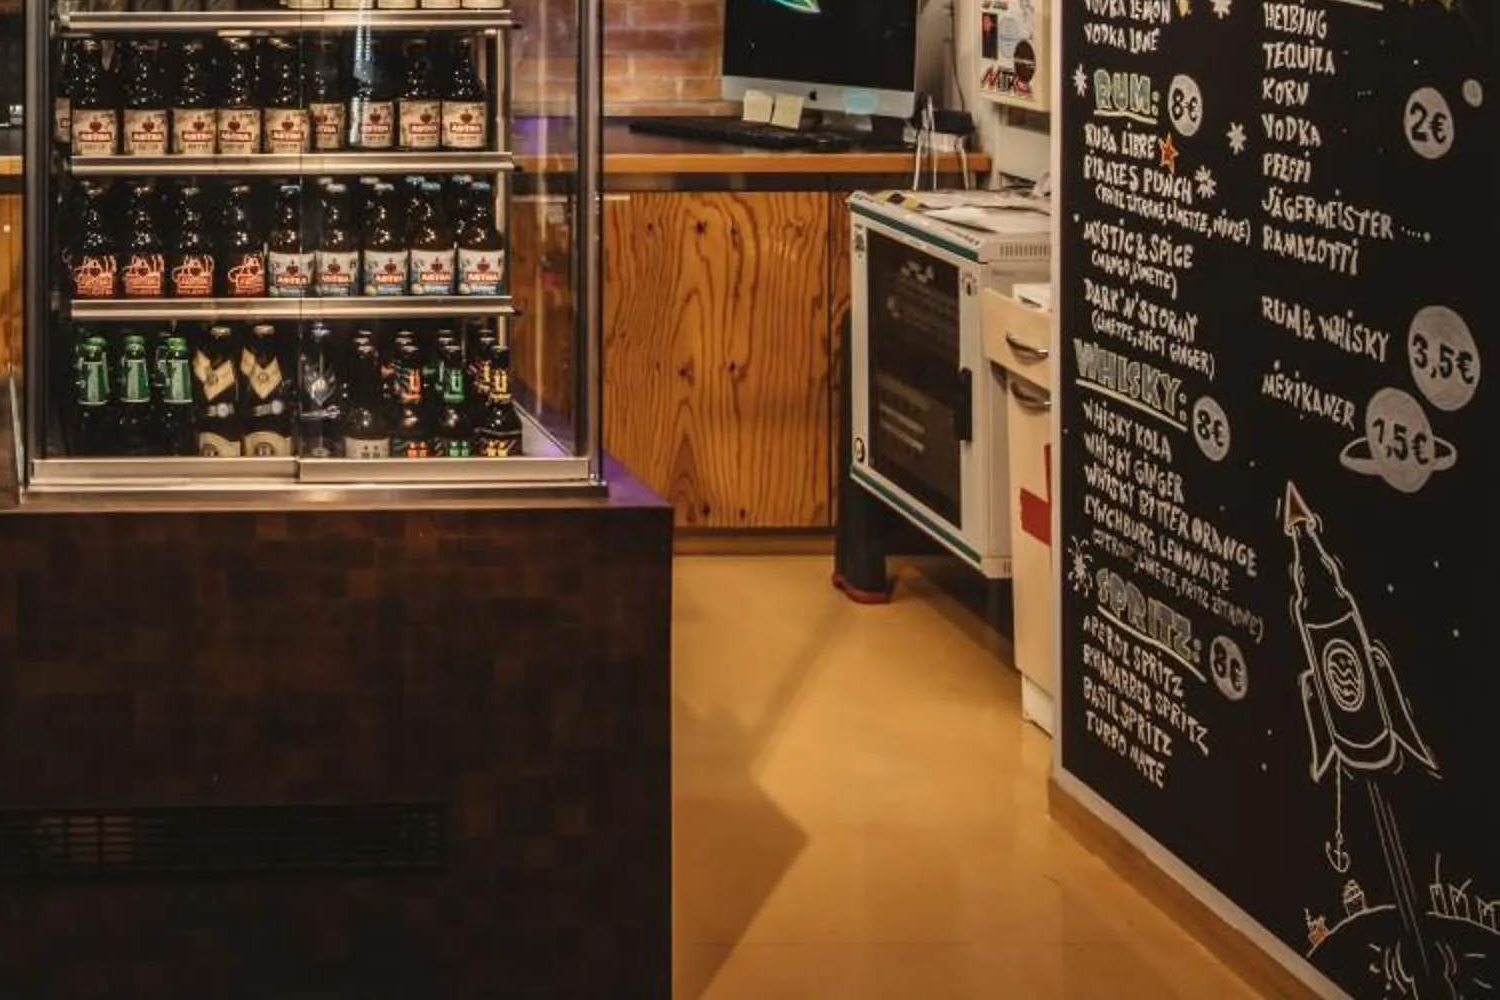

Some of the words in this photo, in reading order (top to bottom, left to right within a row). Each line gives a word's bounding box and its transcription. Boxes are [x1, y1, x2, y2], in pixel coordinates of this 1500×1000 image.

[1083, 22, 1127, 50] VODKA
[1262, 39, 1336, 76] TEQUILA
[1170, 87, 1199, 122] 8€
[1261, 77, 1310, 107] KORN
[1121, 123, 1159, 160] LIBRE
[1261, 113, 1322, 148] VODKA
[1409, 101, 1448, 144] 2€
[1083, 150, 1139, 192] PIRATES
[1143, 168, 1193, 204] PUNCH
[1262, 150, 1312, 184] PFEFFI
[1262, 224, 1360, 276] RAMAZOTTI
[1318, 309, 1390, 363] WHISKY
[1412, 333, 1475, 386] 3,5€
[1082, 398, 1132, 440] WHISKY
[1135, 420, 1172, 462] KOLA
[1261, 371, 1356, 431] MEXIKANER
[1371, 417, 1429, 465] 1,5€
[1083, 432, 1132, 476] WHISKY
[1134, 455, 1185, 503] GINGER
[1084, 463, 1135, 508] WHISKY
[1191, 517, 1257, 578] ORANGE
[1133, 645, 1184, 698] SPRITZ
